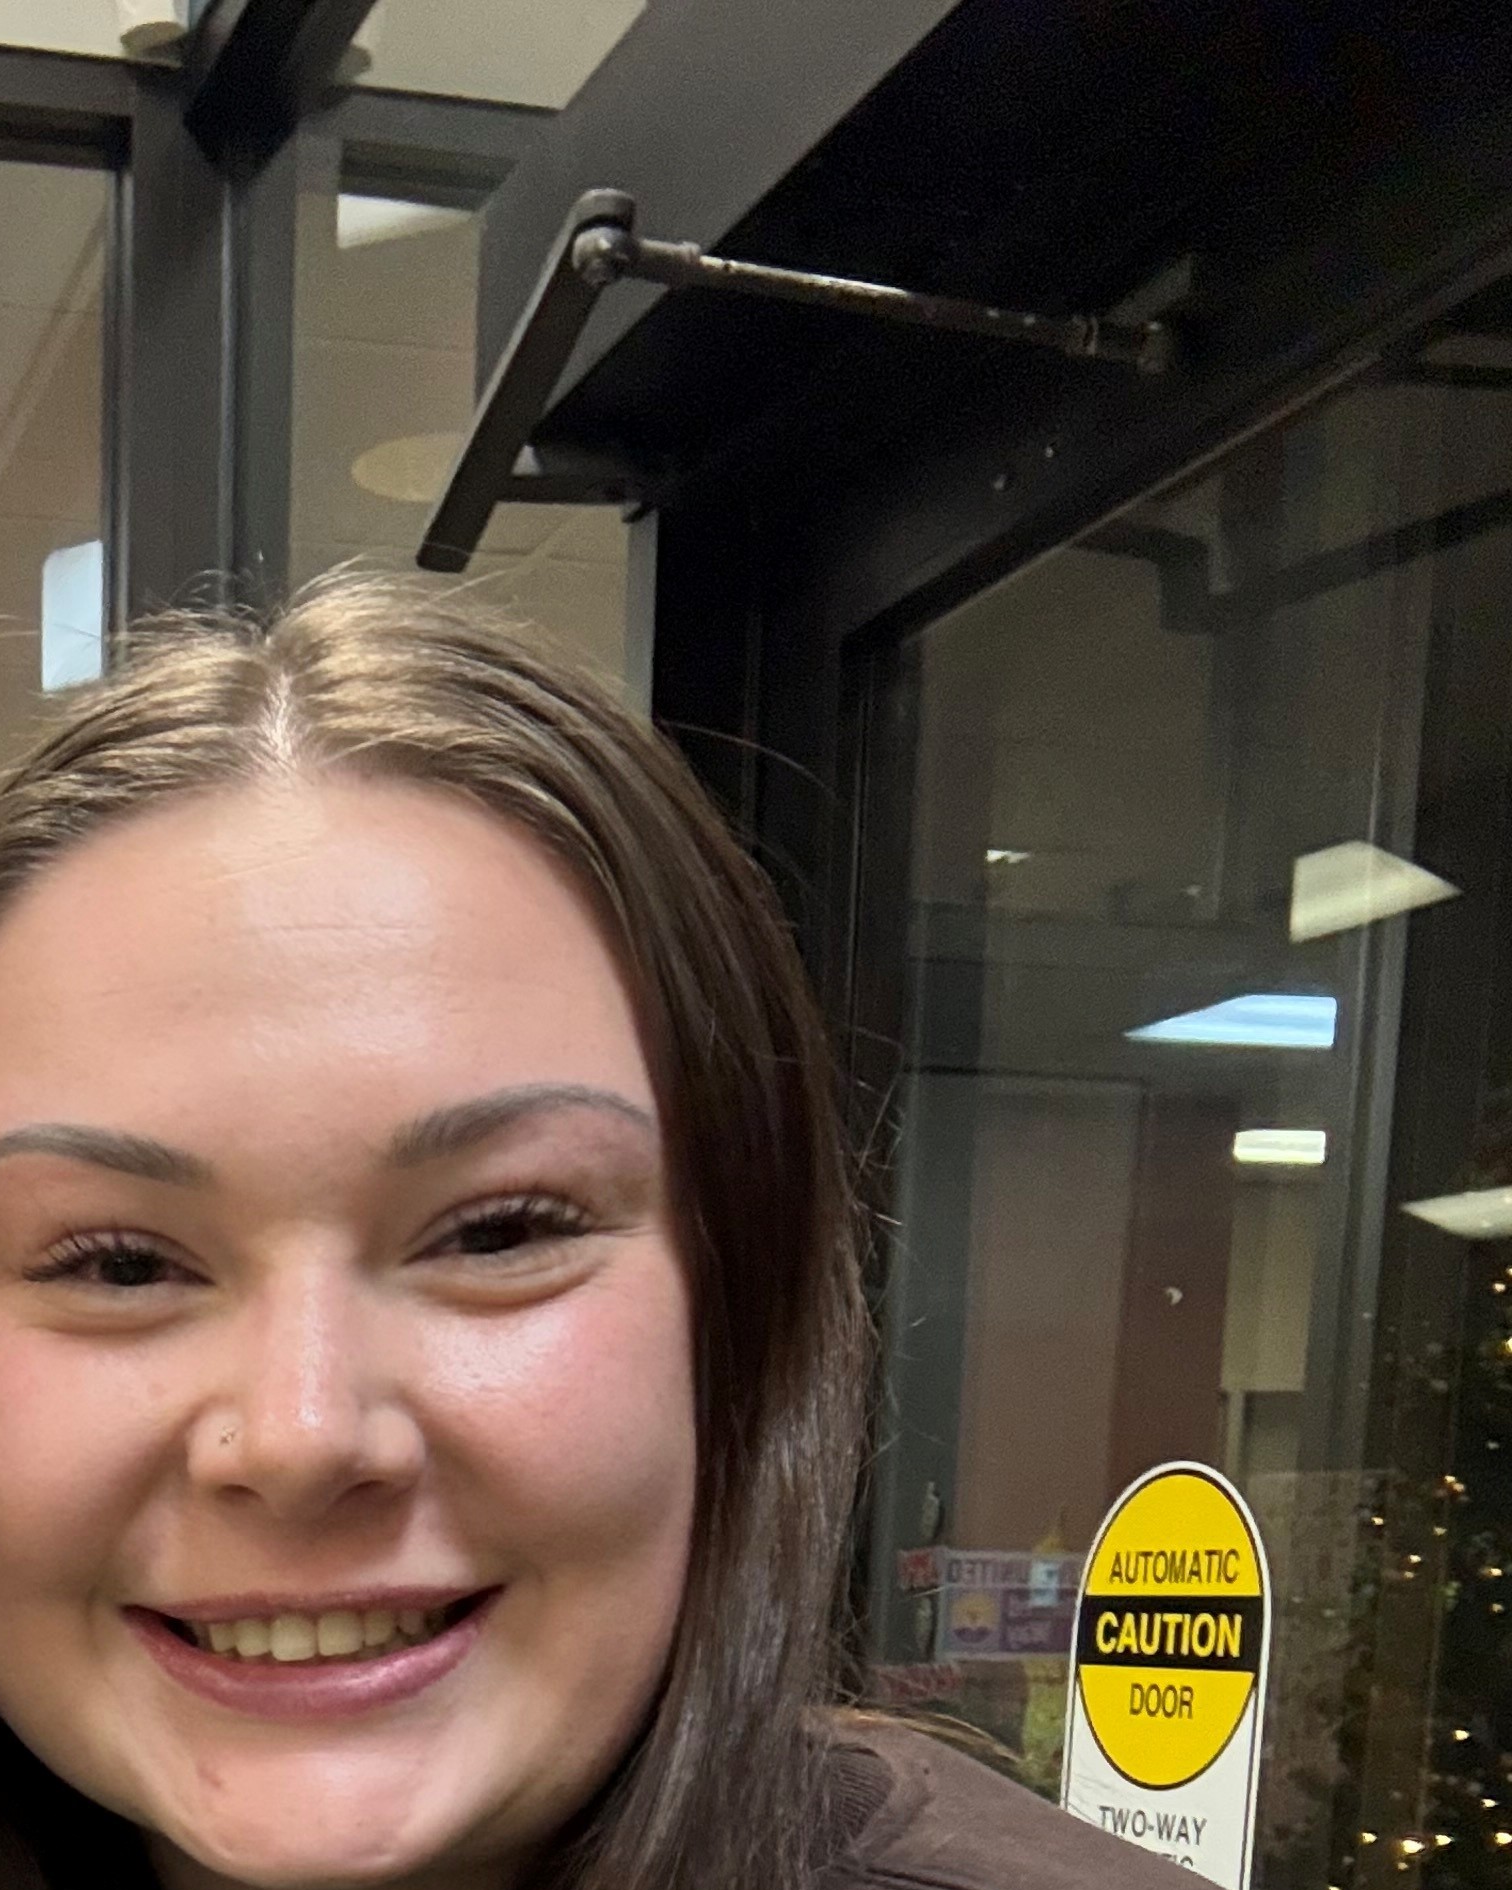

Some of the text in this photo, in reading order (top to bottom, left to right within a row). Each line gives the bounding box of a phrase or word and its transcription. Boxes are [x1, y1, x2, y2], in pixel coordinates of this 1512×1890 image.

[1108, 1549, 1240, 1585] AUTOMATIC
[1096, 1611, 1242, 1657] CAUTION
[1129, 1683, 1194, 1719] DOOR
[1098, 1805, 1208, 1846] TWO-WAY
